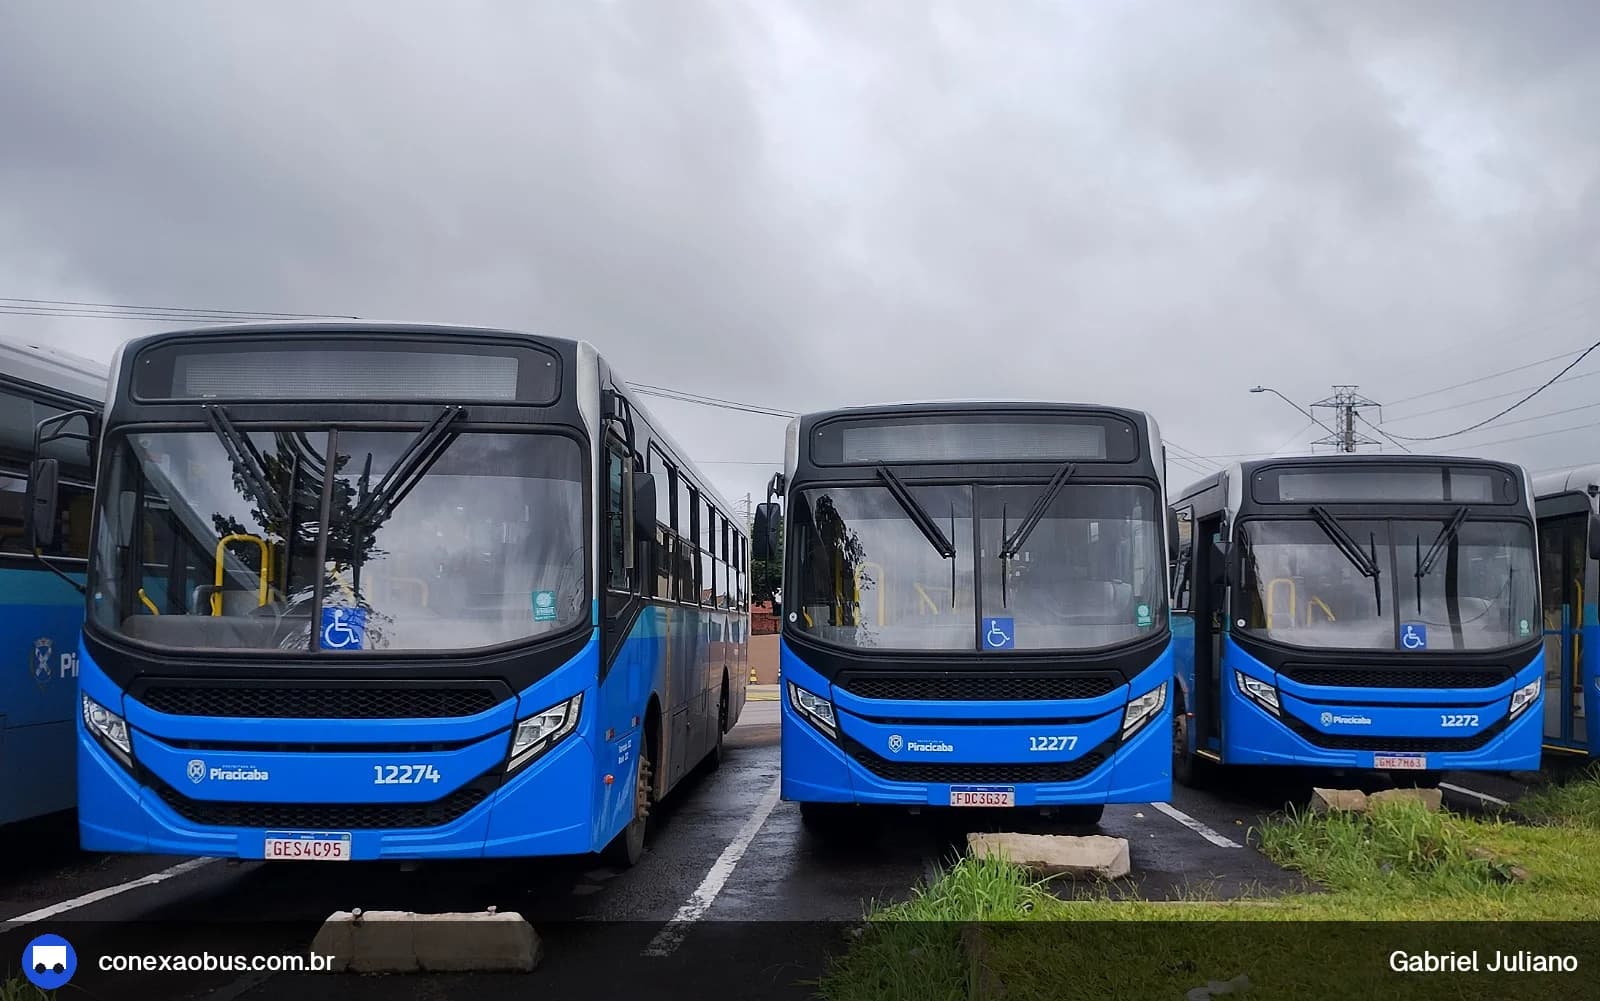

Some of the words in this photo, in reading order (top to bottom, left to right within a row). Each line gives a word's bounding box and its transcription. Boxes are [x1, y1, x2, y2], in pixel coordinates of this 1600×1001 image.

[1440, 714, 1479, 727] 12272
[907, 742, 954, 752] Piracicaba
[1029, 736, 1078, 751] 12277
[210, 768, 269, 781] Piracicaba
[374, 765, 441, 785] 12274
[956, 793, 1008, 805] FDC3G32
[273, 841, 342, 857] GES4C95
